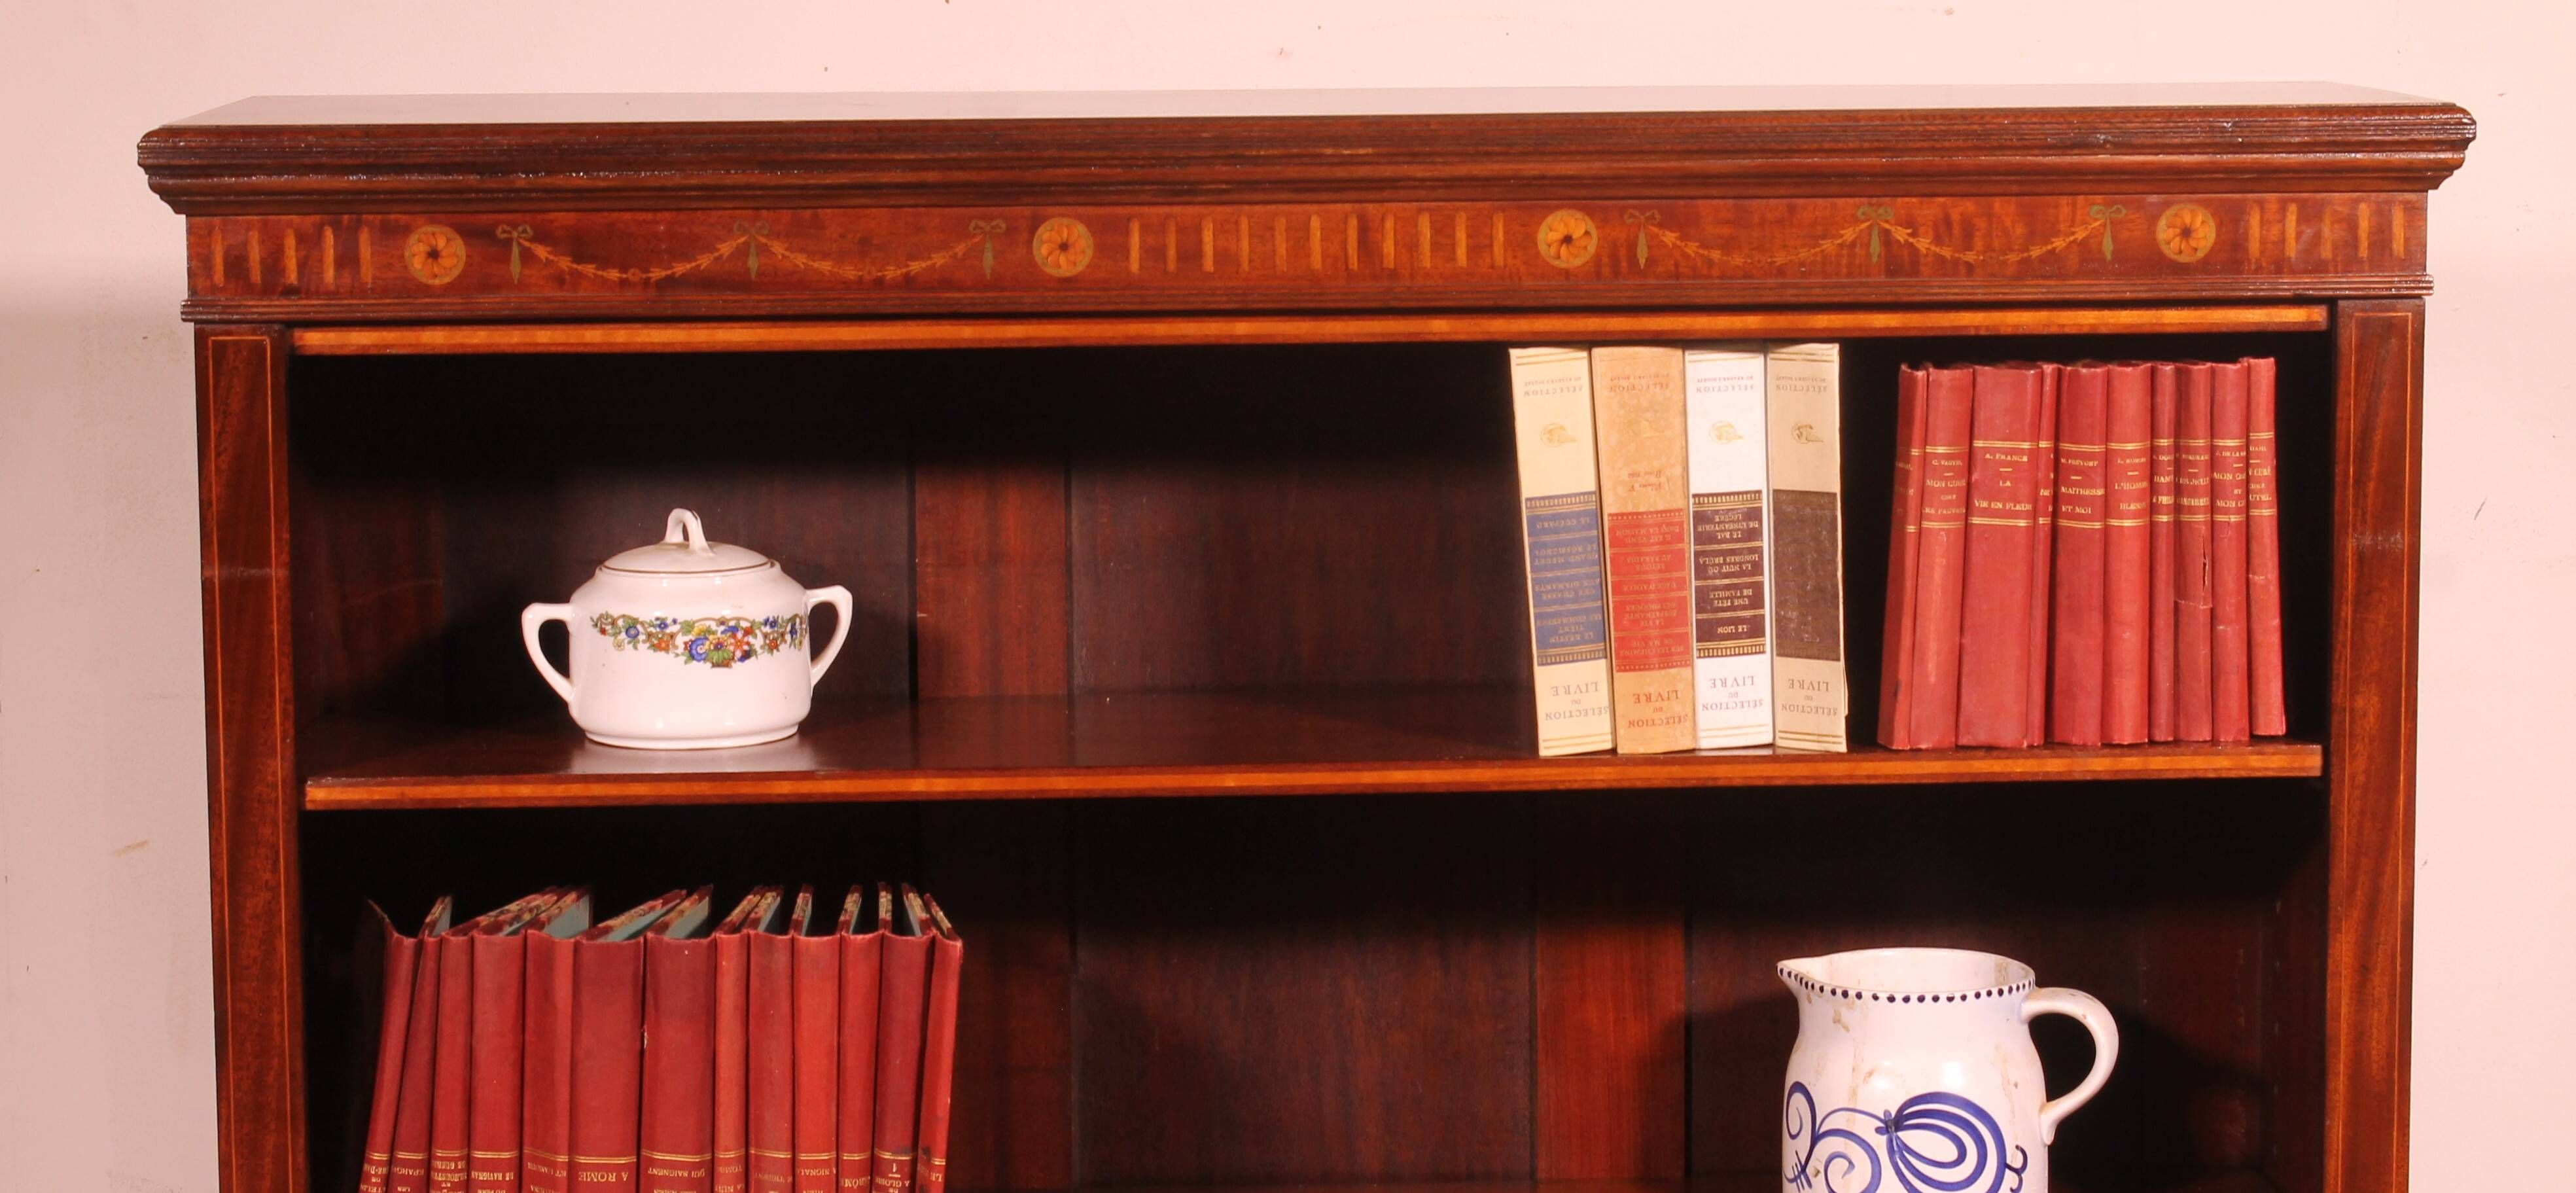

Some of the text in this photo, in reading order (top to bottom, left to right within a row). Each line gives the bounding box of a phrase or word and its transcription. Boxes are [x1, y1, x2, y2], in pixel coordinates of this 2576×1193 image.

[1996, 453, 2028, 462] FRANCE
[1726, 554, 1758, 562] LONDRES
[1709, 590, 1740, 598] FAMILLE
[1733, 597, 1748, 606] UNE
[1717, 626, 1735, 634] LION
[1708, 675, 1755, 688] LIVRE
[1788, 679, 1829, 692] LIVRE
[1551, 681, 1598, 696] LIVRE
[1632, 690, 1679, 704] LIVRE
[1545, 706, 1609, 721] SÉLECTION
[578, 1172, 628, 1182] A ROME
[648, 1167, 705, 1178] QUI SAIGNENT
